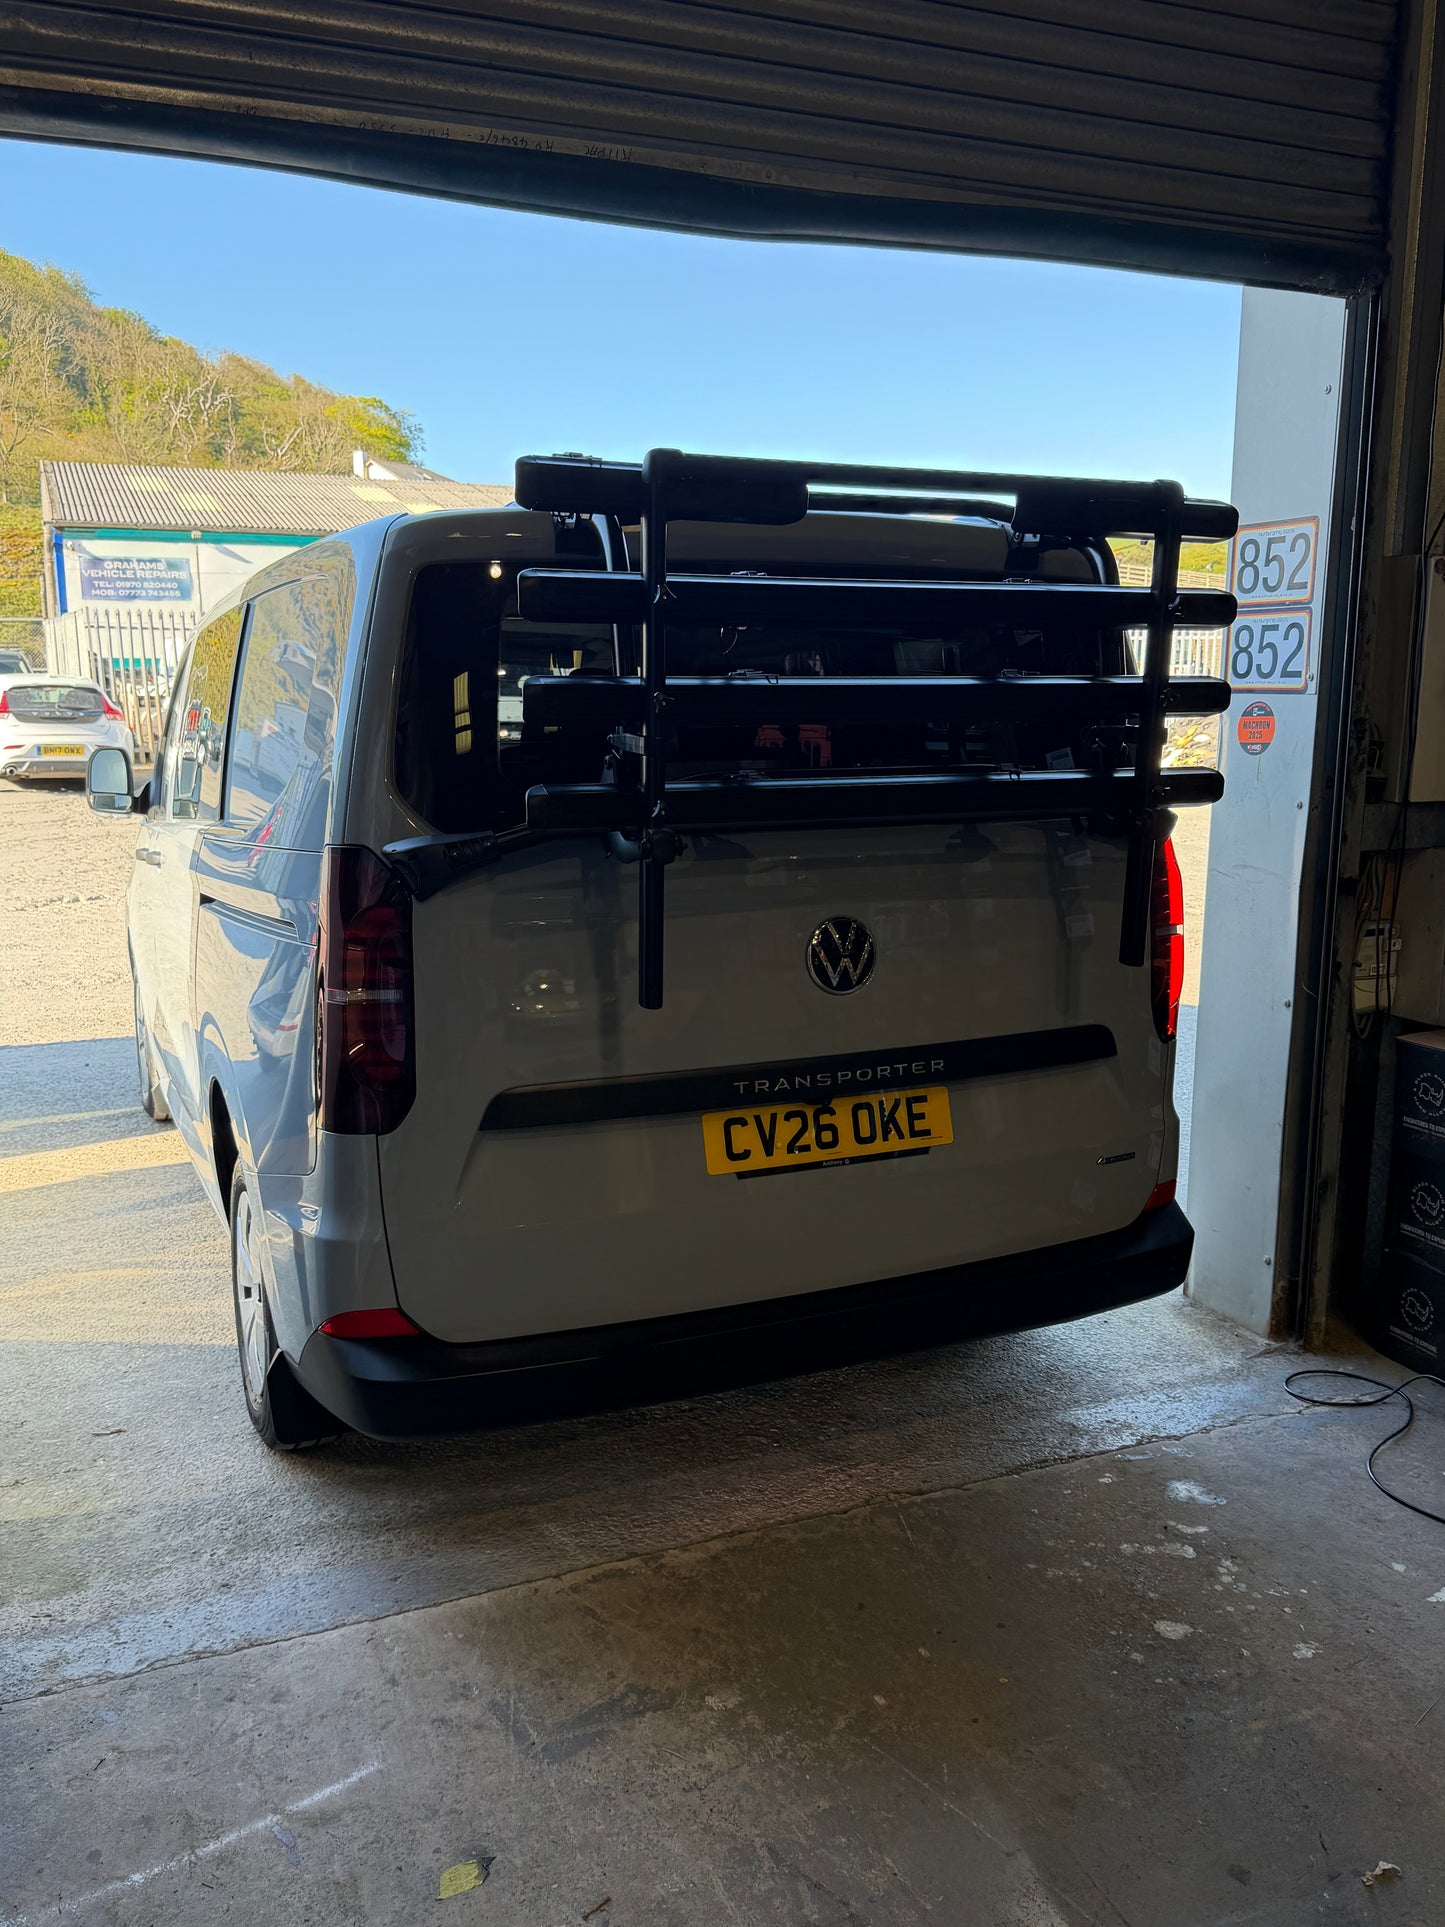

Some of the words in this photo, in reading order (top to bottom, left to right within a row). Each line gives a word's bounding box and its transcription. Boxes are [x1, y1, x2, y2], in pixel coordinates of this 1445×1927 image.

[81, 569, 135, 578] VEHICLE
[136, 570, 188, 579] REPAIRS
[104, 561, 165, 570] GRAHAMS
[1237, 532, 1311, 594] 852
[93, 580, 114, 588] TEL:
[1231, 622, 1305, 680] 852
[734, 1059, 945, 1094] TRANSPORTER
[722, 1105, 840, 1162] CV26
[851, 1094, 932, 1145] OKE
